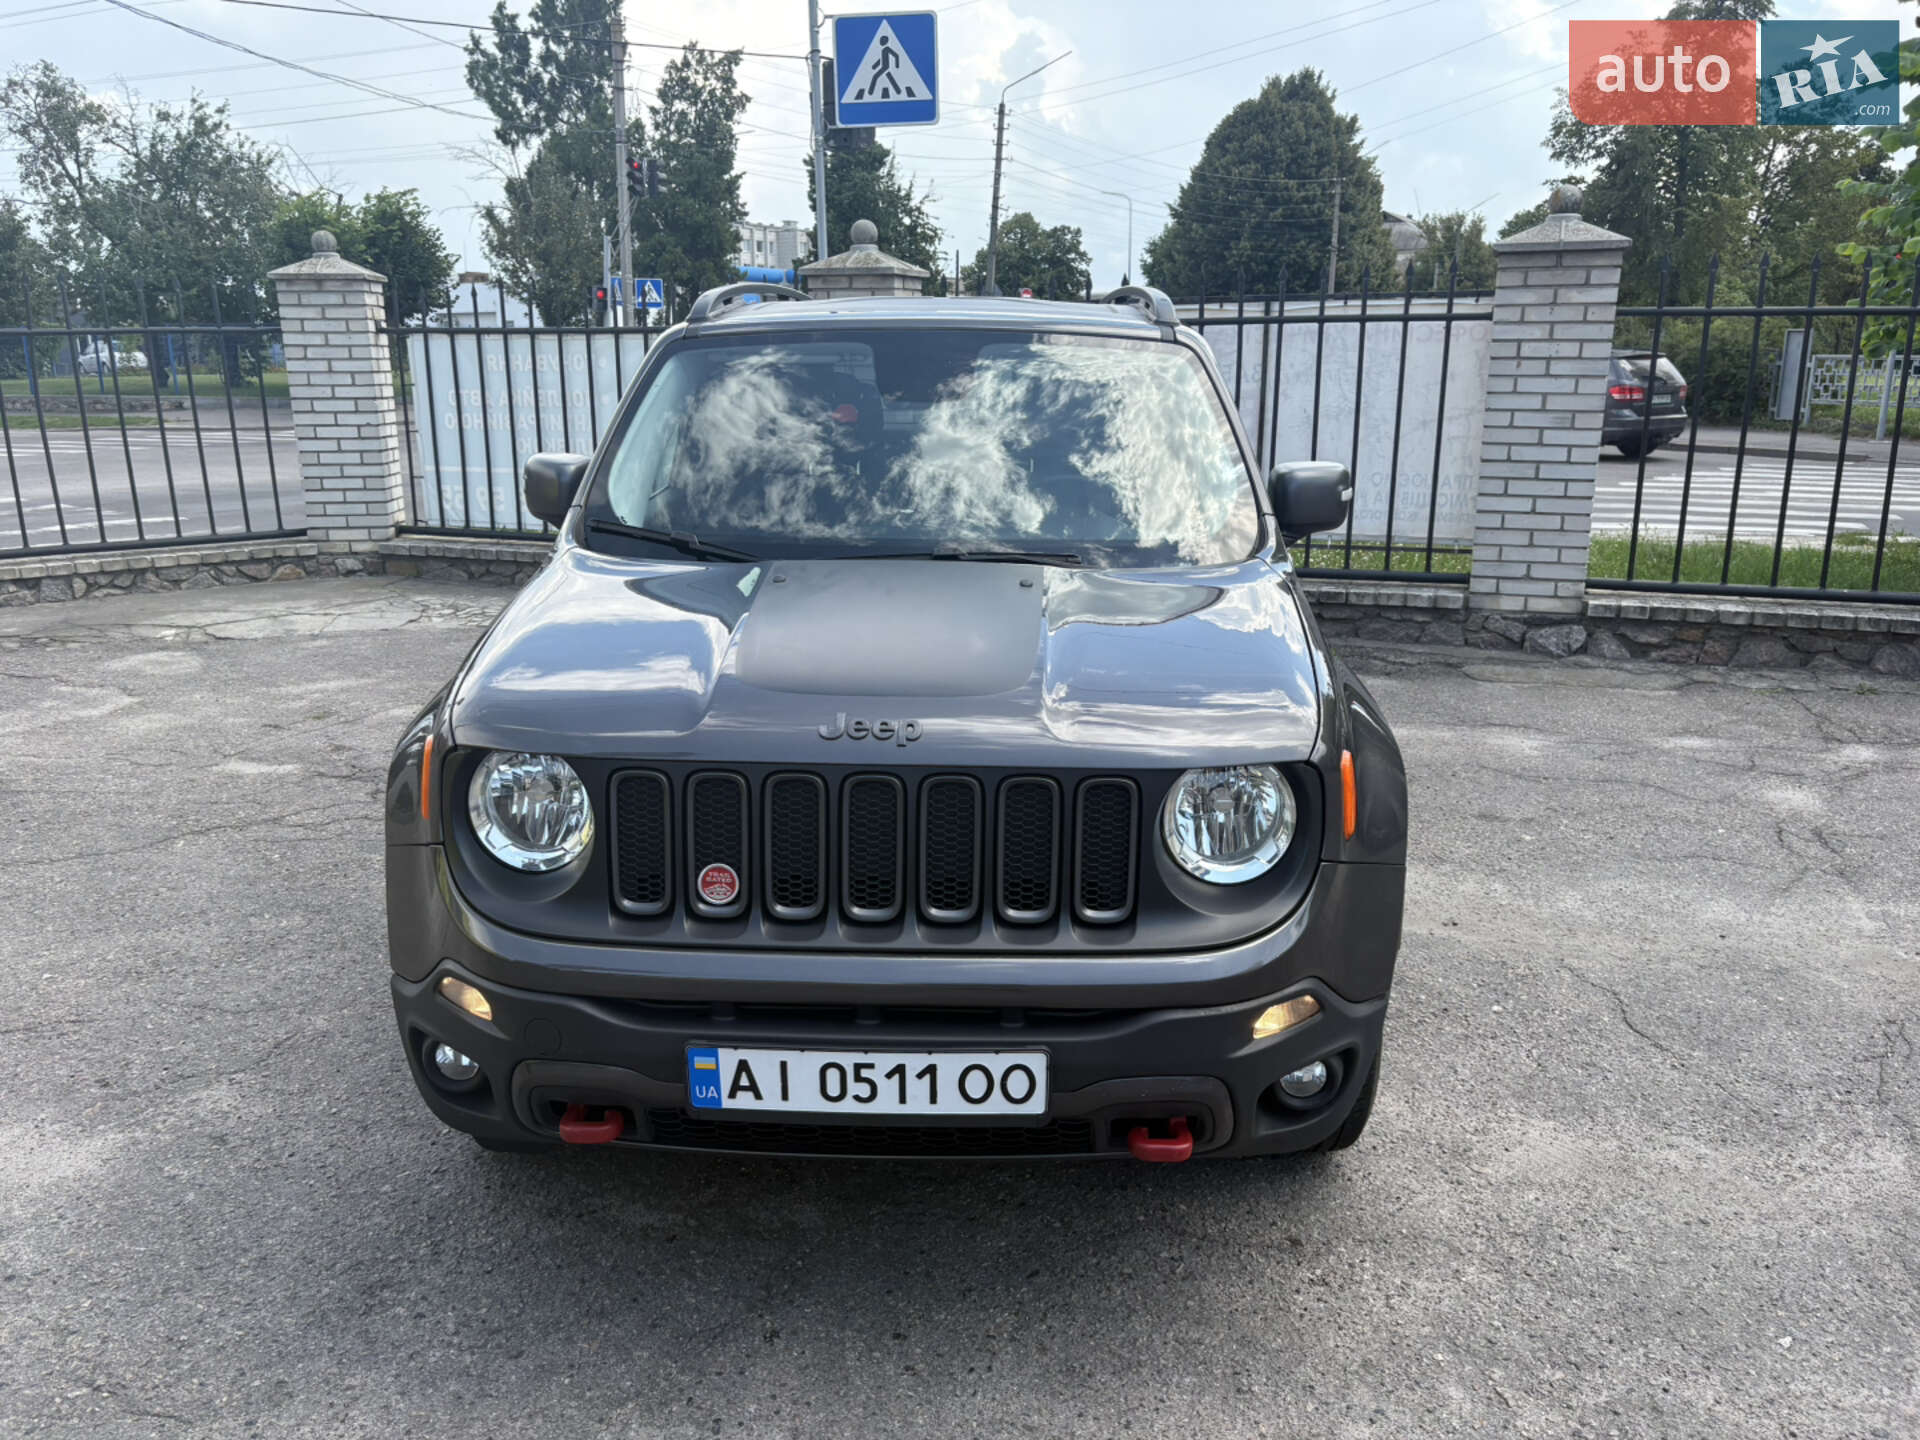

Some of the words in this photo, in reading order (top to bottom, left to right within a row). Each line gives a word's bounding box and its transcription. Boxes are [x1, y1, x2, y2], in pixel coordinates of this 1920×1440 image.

[818, 712, 922, 747] Jeep
[696, 1085, 719, 1099] UA
[819, 1061, 937, 1105] 0511
[958, 1063, 1037, 1105] OO
